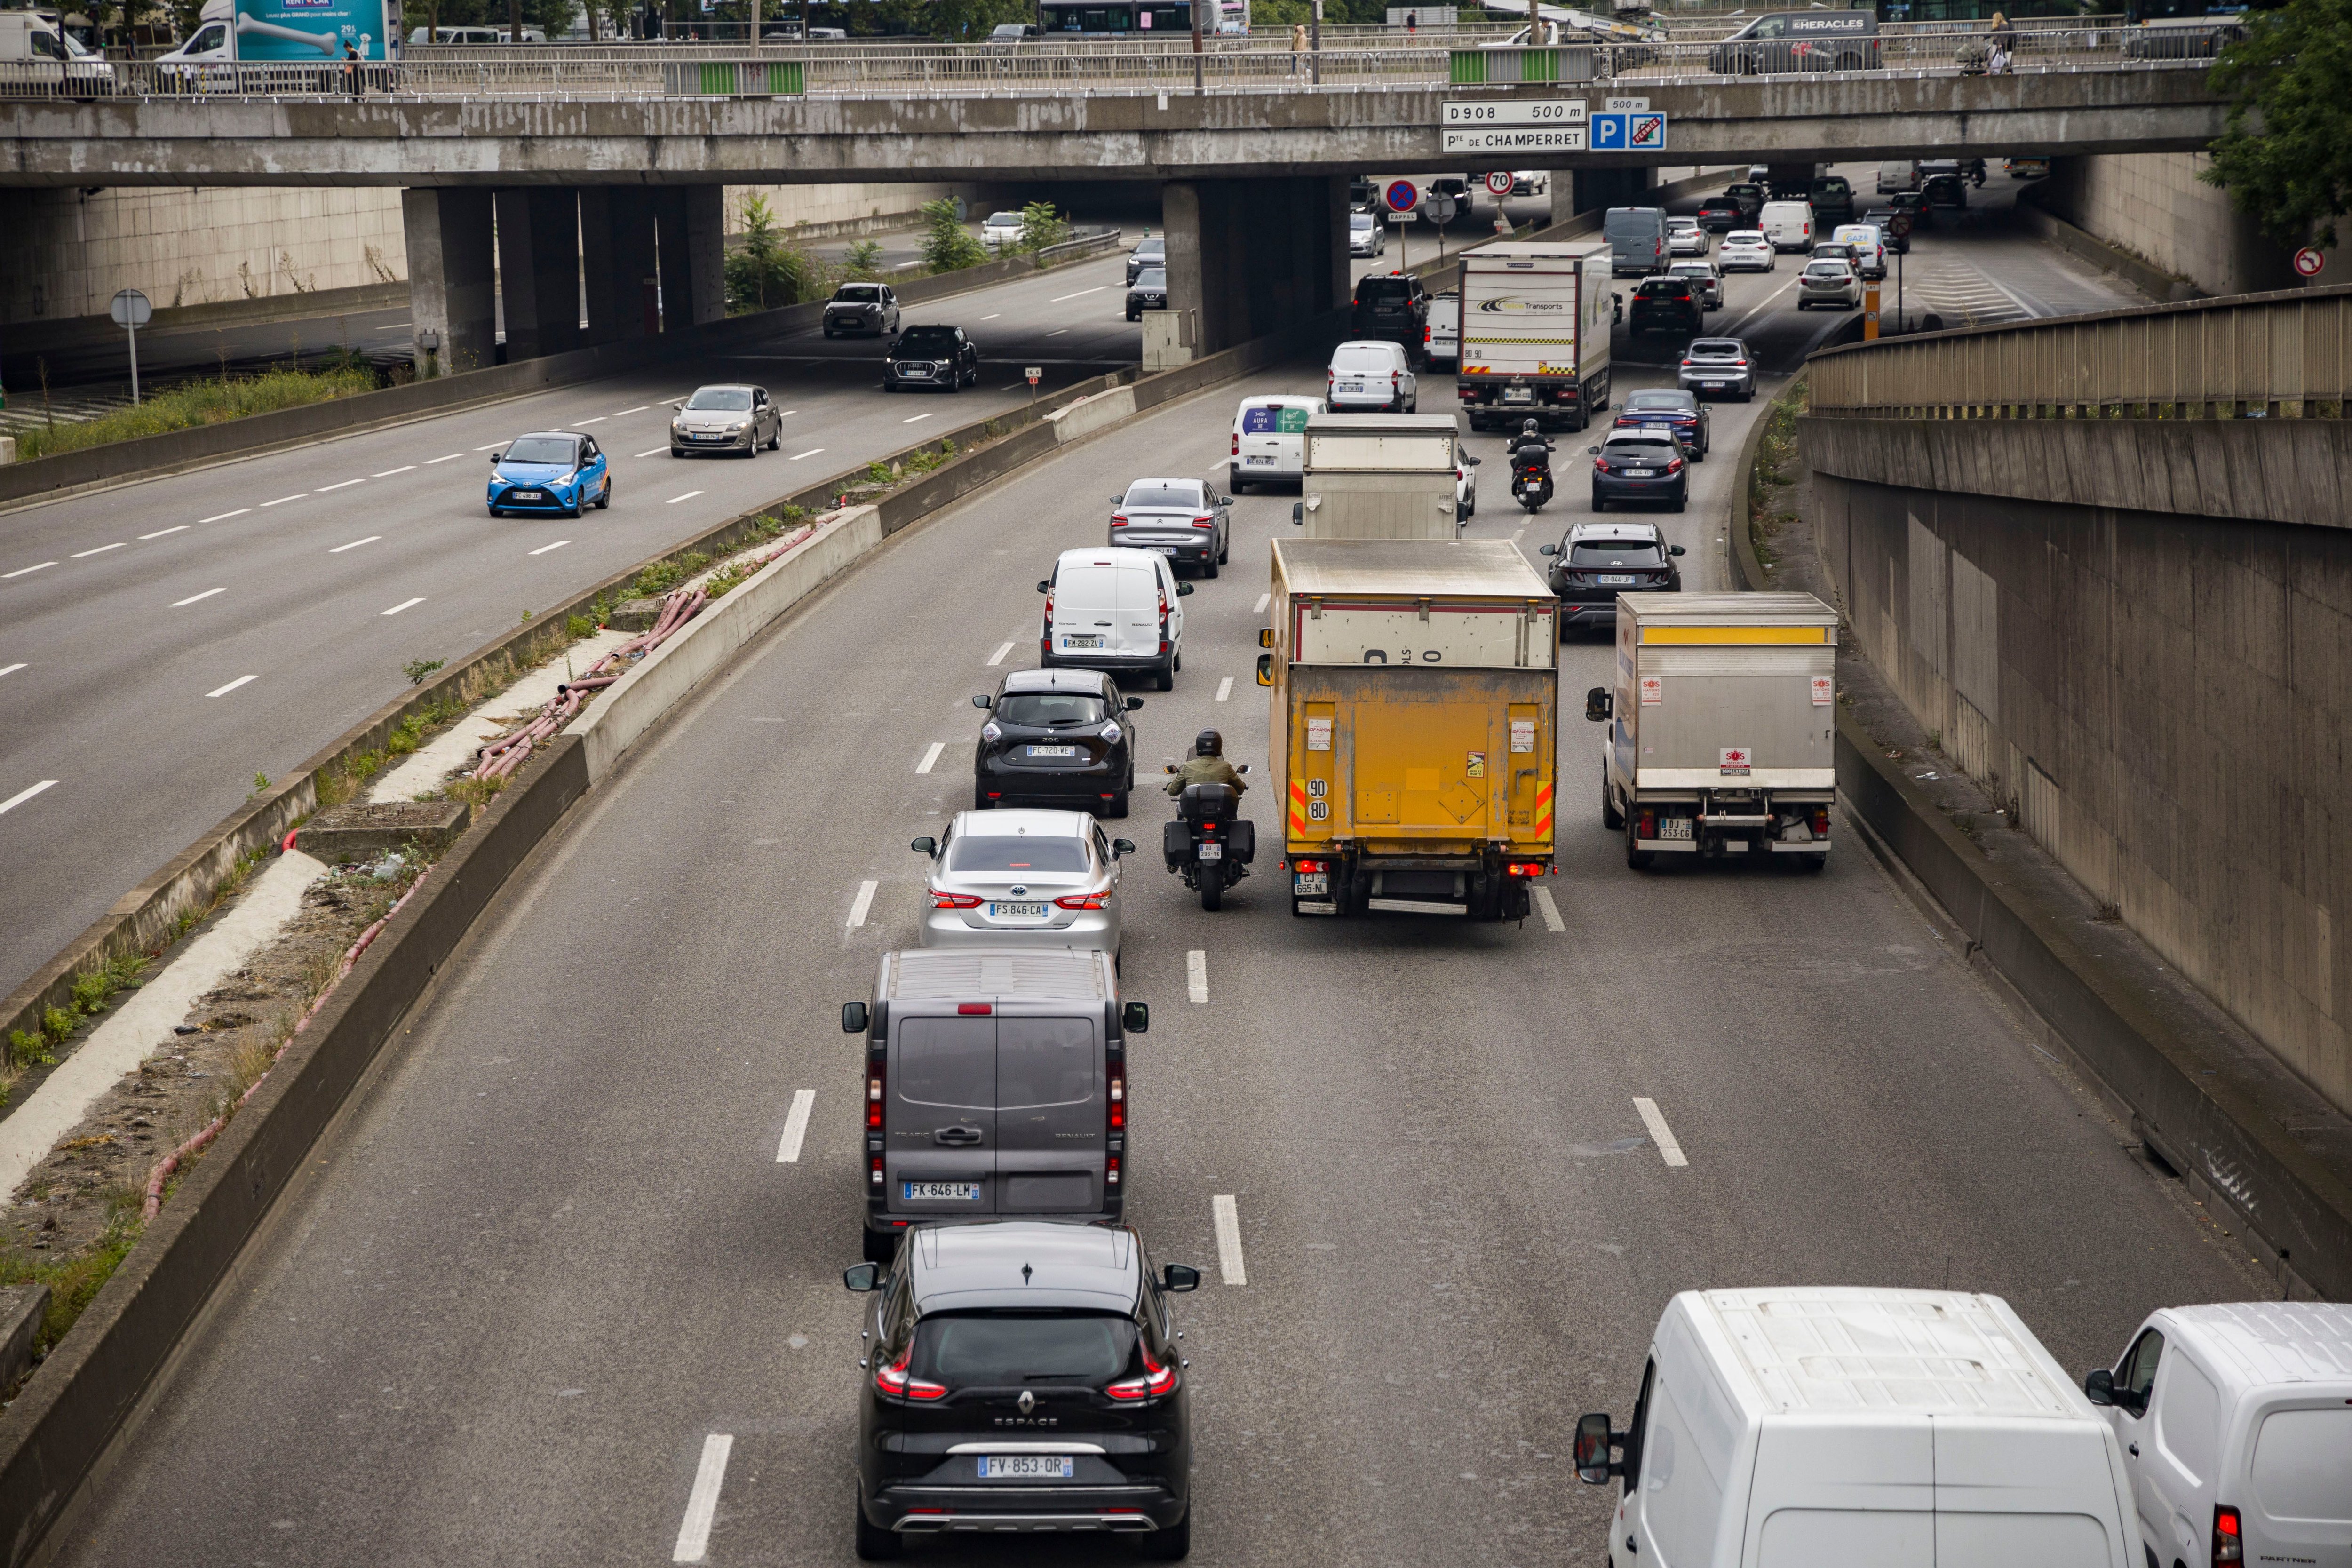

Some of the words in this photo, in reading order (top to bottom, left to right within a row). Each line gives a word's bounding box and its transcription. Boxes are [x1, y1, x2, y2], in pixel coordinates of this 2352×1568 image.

[1800, 20, 1864, 29] HERACLES
[1532, 106, 1563, 118] 500
[1570, 108, 1580, 117] m
[1600, 120, 1617, 143] P
[1636, 119, 1658, 141] FERMÉE
[1486, 134, 1580, 146] CHAMPERRET
[1492, 175, 1508, 186] 70
[1311, 780, 1325, 796] 90
[1311, 802, 1326, 818] 80
[1663, 829, 1689, 837] 253-CG
[1297, 884, 1325, 893] 665-NL
[997, 905, 1041, 915] FS-846-CA
[913, 1184, 970, 1196] FK-646-LM
[989, 1458, 1061, 1473] FV-853-QR
